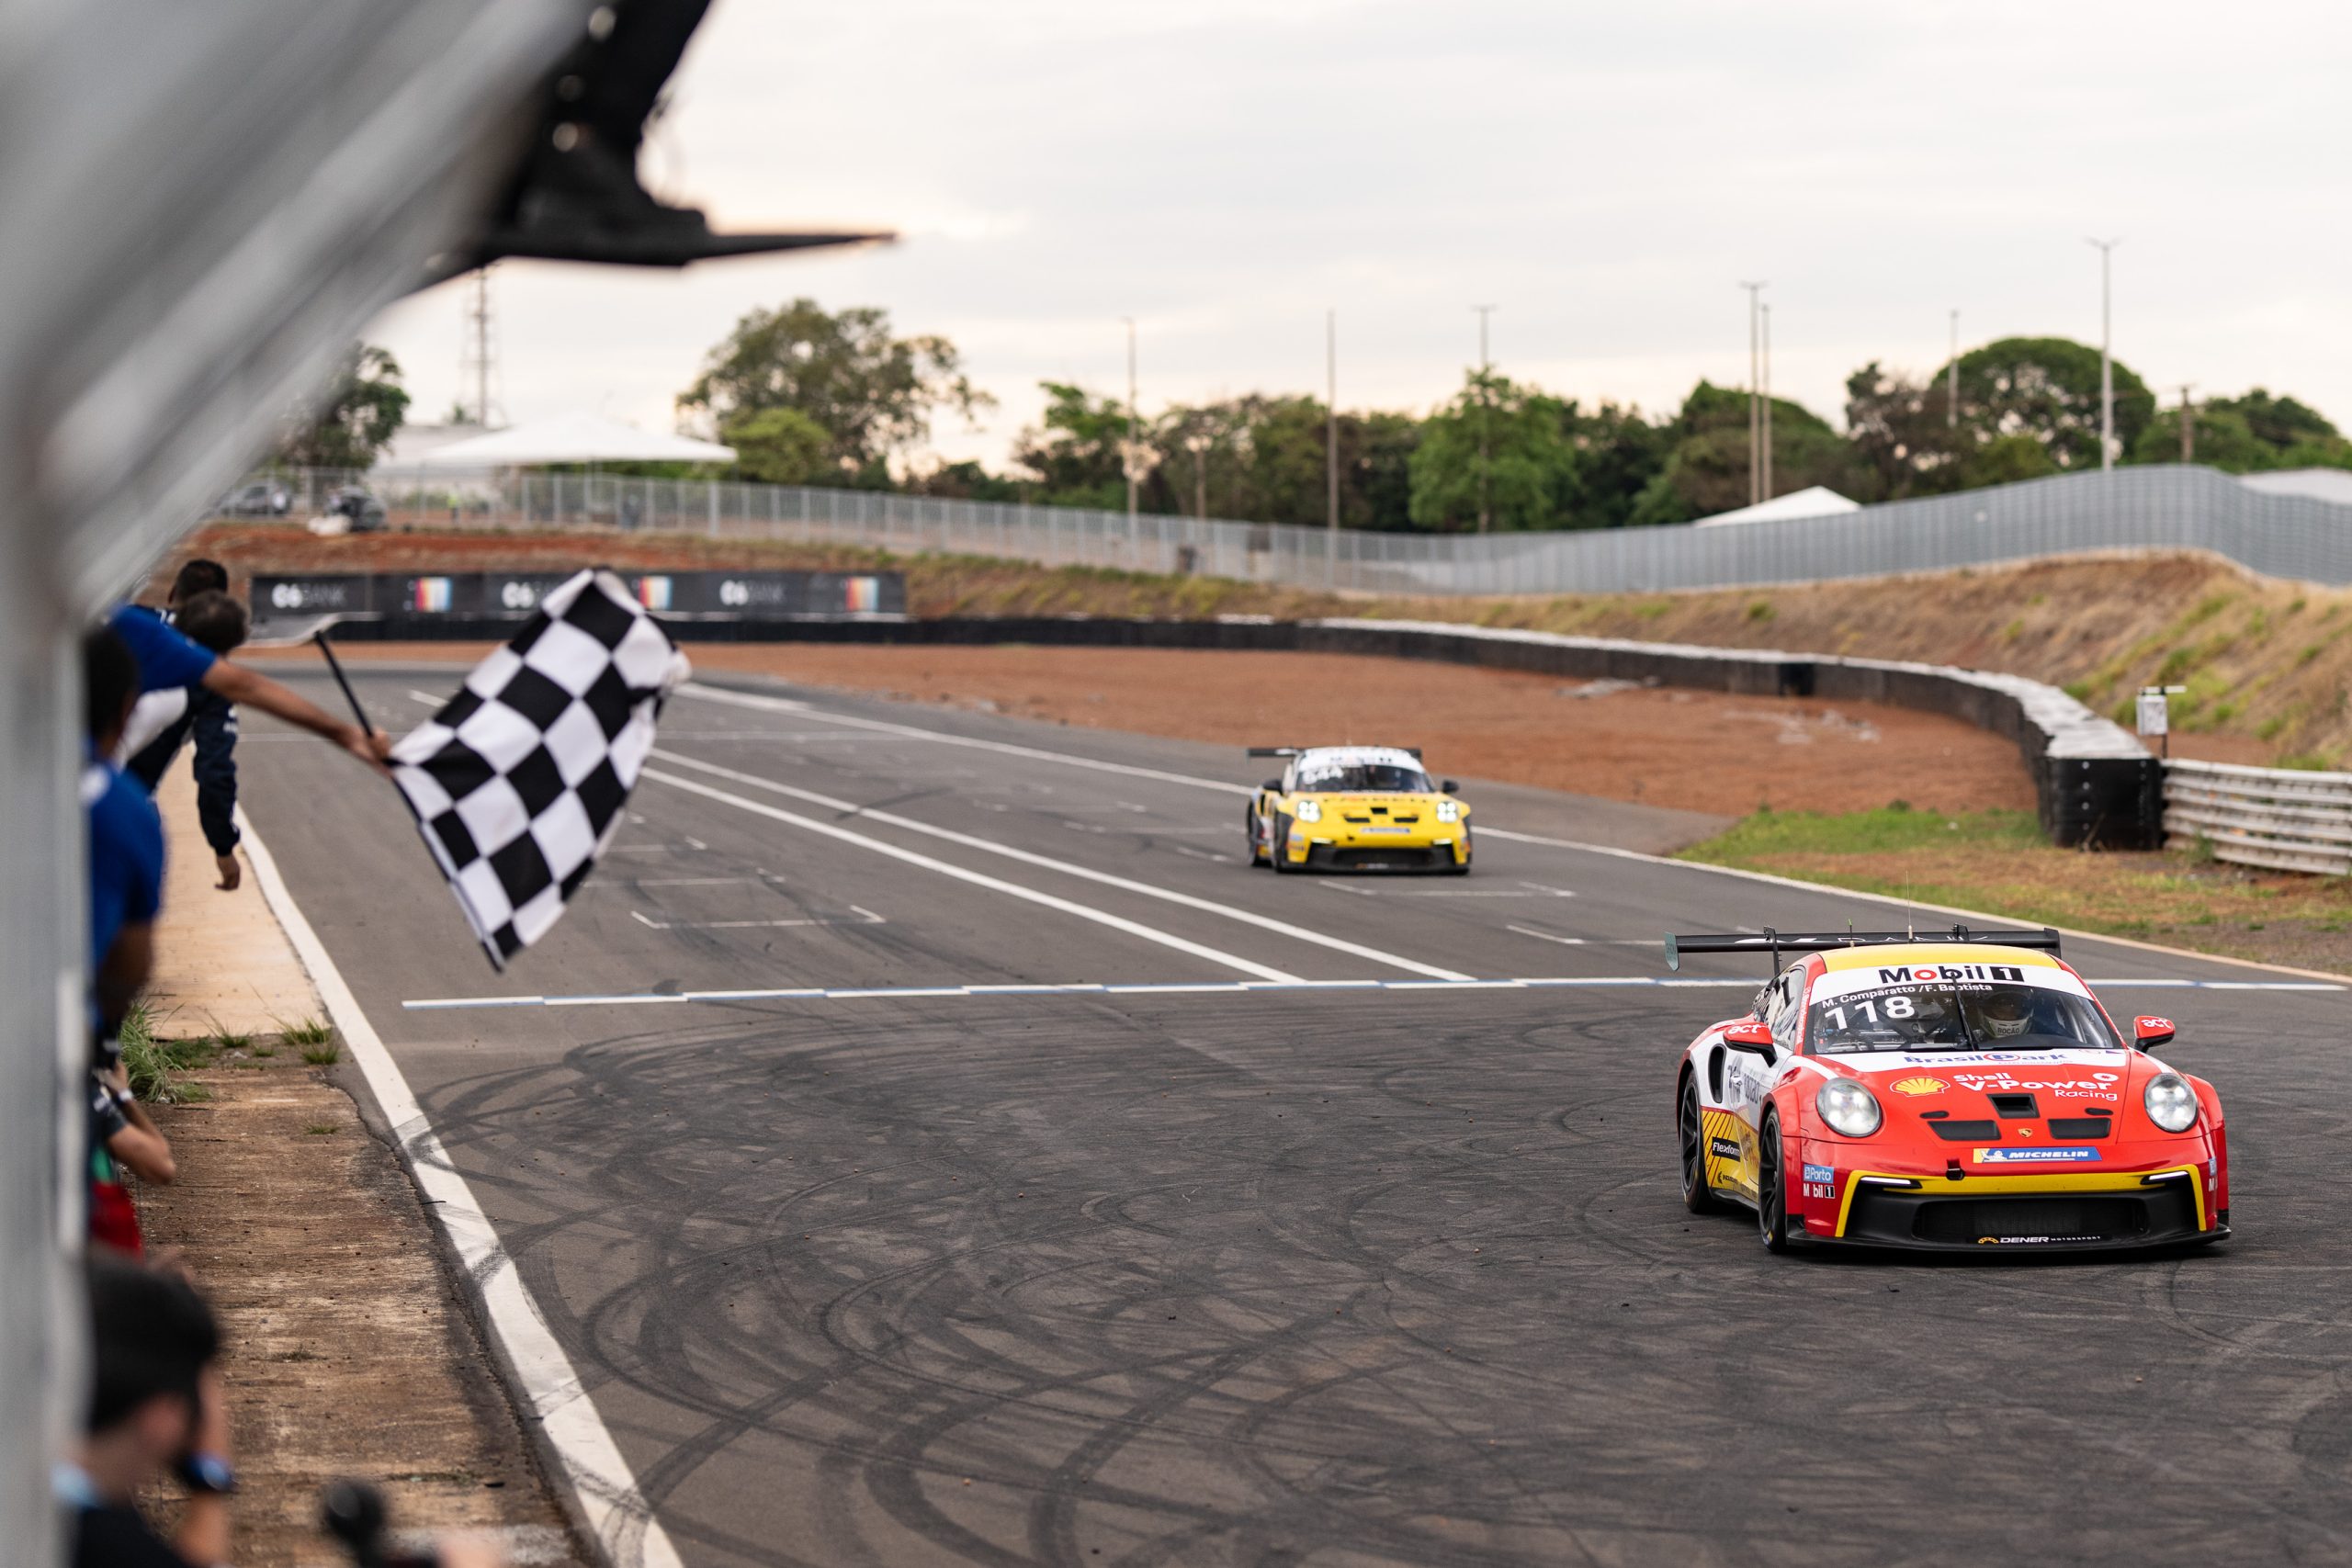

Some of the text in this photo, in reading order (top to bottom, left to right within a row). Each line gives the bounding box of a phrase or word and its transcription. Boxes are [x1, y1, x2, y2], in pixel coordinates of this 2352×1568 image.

[1879, 965, 1985, 984] Mobil
[1822, 998, 1838, 1009] M.
[1840, 986, 1916, 1003] Comparatto
[1825, 996, 1915, 1031] 118
[1728, 1024, 1760, 1034] act
[2142, 1018, 2171, 1029] act
[1953, 1072, 2012, 1082] Shell
[1961, 1080, 2113, 1091] V-Power
[2054, 1089, 2118, 1101] Racing
[1713, 1142, 1740, 1157] Flexform
[2008, 1150, 2089, 1159] MICHELIN
[1810, 1167, 1832, 1181] Porto
[1803, 1183, 1824, 1198] Mbil
